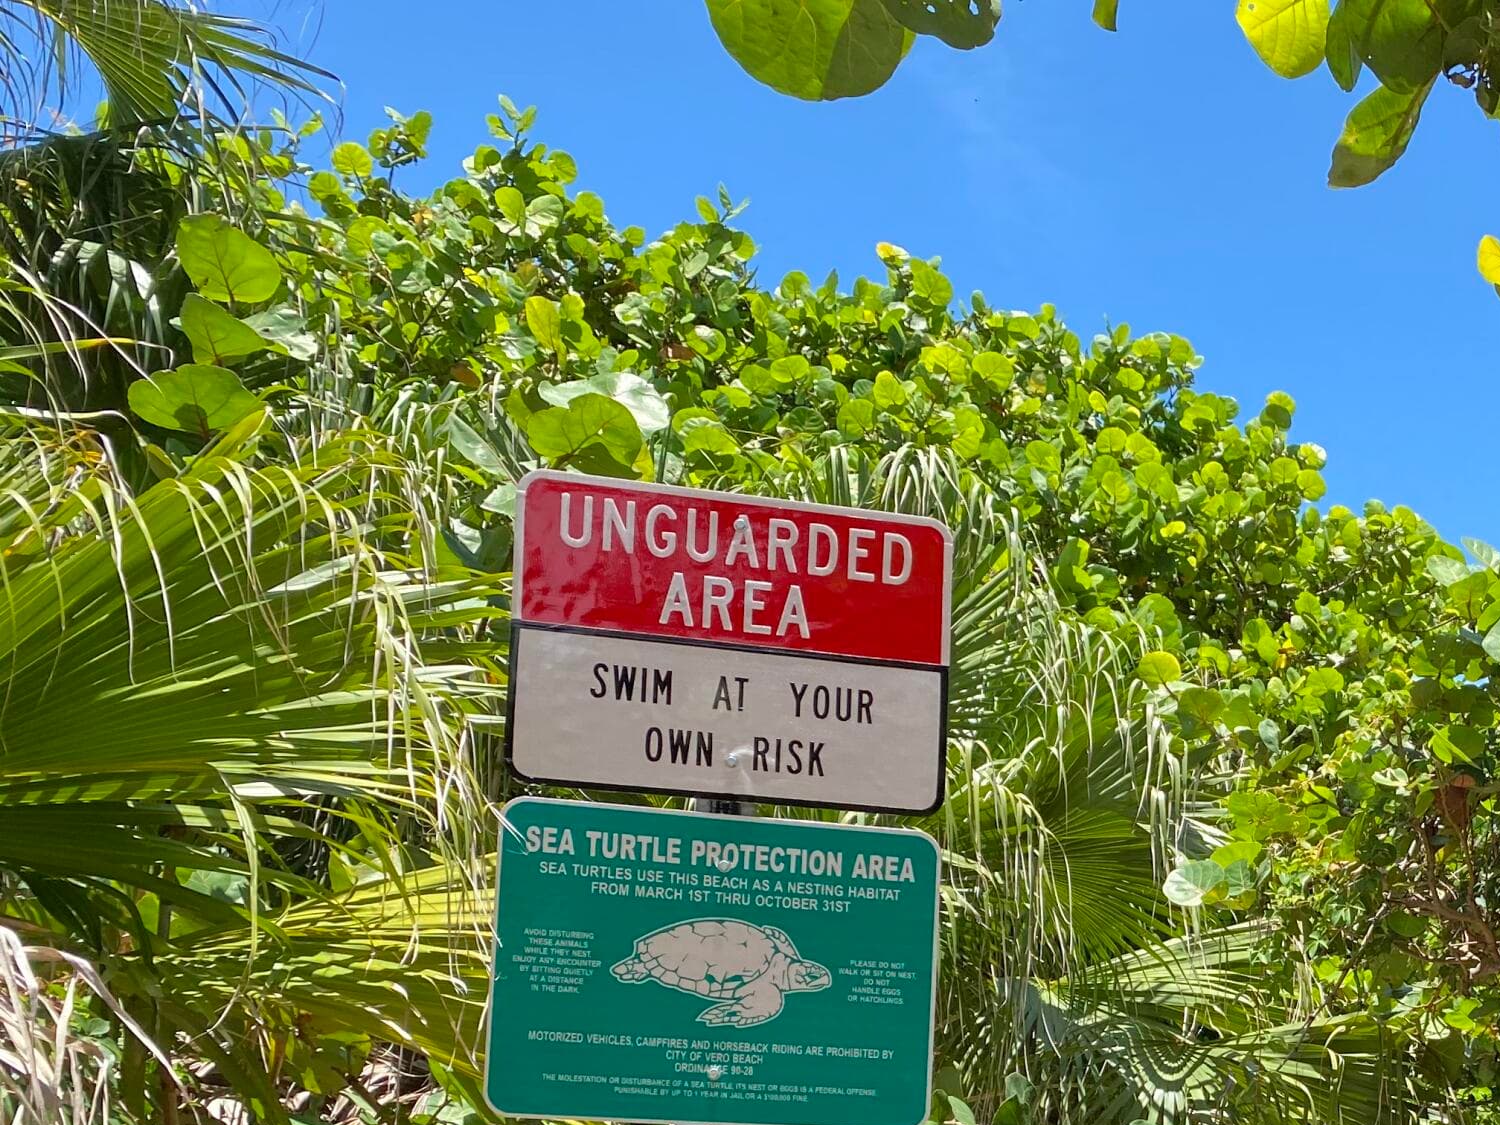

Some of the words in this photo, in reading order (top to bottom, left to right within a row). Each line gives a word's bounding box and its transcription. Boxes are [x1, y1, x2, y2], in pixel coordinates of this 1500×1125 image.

[559, 492, 913, 588] UNGUARDED
[658, 570, 813, 641] AREA
[590, 661, 673, 706] SWIM
[713, 674, 749, 714] AT
[789, 682, 874, 725] YOUR
[644, 725, 713, 768] OWN
[752, 736, 826, 779] RISK
[525, 826, 576, 857] SEA
[585, 830, 682, 864] TURTLE
[691, 839, 843, 878] PROTECTION
[851, 853, 917, 883] AREA
[539, 862, 568, 876] SEA
[572, 864, 633, 881] TURTLES
[637, 869, 664, 883] USE
[668, 871, 699, 886] THIS
[703, 874, 748, 890] BEACH
[752, 878, 770, 892] AS
[774, 880, 784, 892] A
[787, 881, 844, 897] NESTING
[848, 886, 901, 902] HABITAT
[591, 882, 630, 897] FROM
[634, 885, 683, 901] MARCH
[687, 889, 711, 903] 1ST
[715, 891, 751, 905] THRU
[754, 893, 819, 910] OCTOBER
[822, 898, 851, 913] 31ST
[524, 946, 548, 955] WHILE
[550, 948, 569, 956] THEY
[529, 937, 553, 946] THESE
[555, 939, 588, 948] ANIMALS
[529, 974, 537, 982] AT
[540, 975, 546, 983] A
[547, 976, 584, 985] DISTANCE
[541, 984, 556, 992] THE
[864, 978, 874, 986] DO
[875, 979, 891, 987] NOT
[528, 1030, 583, 1043] MOTORIZED
[636, 1036, 689, 1049] CAMPFIRES
[690, 1039, 711, 1051] AND
[713, 1041, 768, 1054] HORSEBACK
[771, 1044, 803, 1055] RIDING
[805, 1046, 823, 1056] ARE
[826, 1047, 880, 1059] PROHIBITED
[882, 1050, 893, 1060] BY
[665, 1050, 687, 1061] CITY
[689, 1051, 702, 1062] OF
[705, 1052, 730, 1063] VERO
[732, 1054, 763, 1065] BEACH
